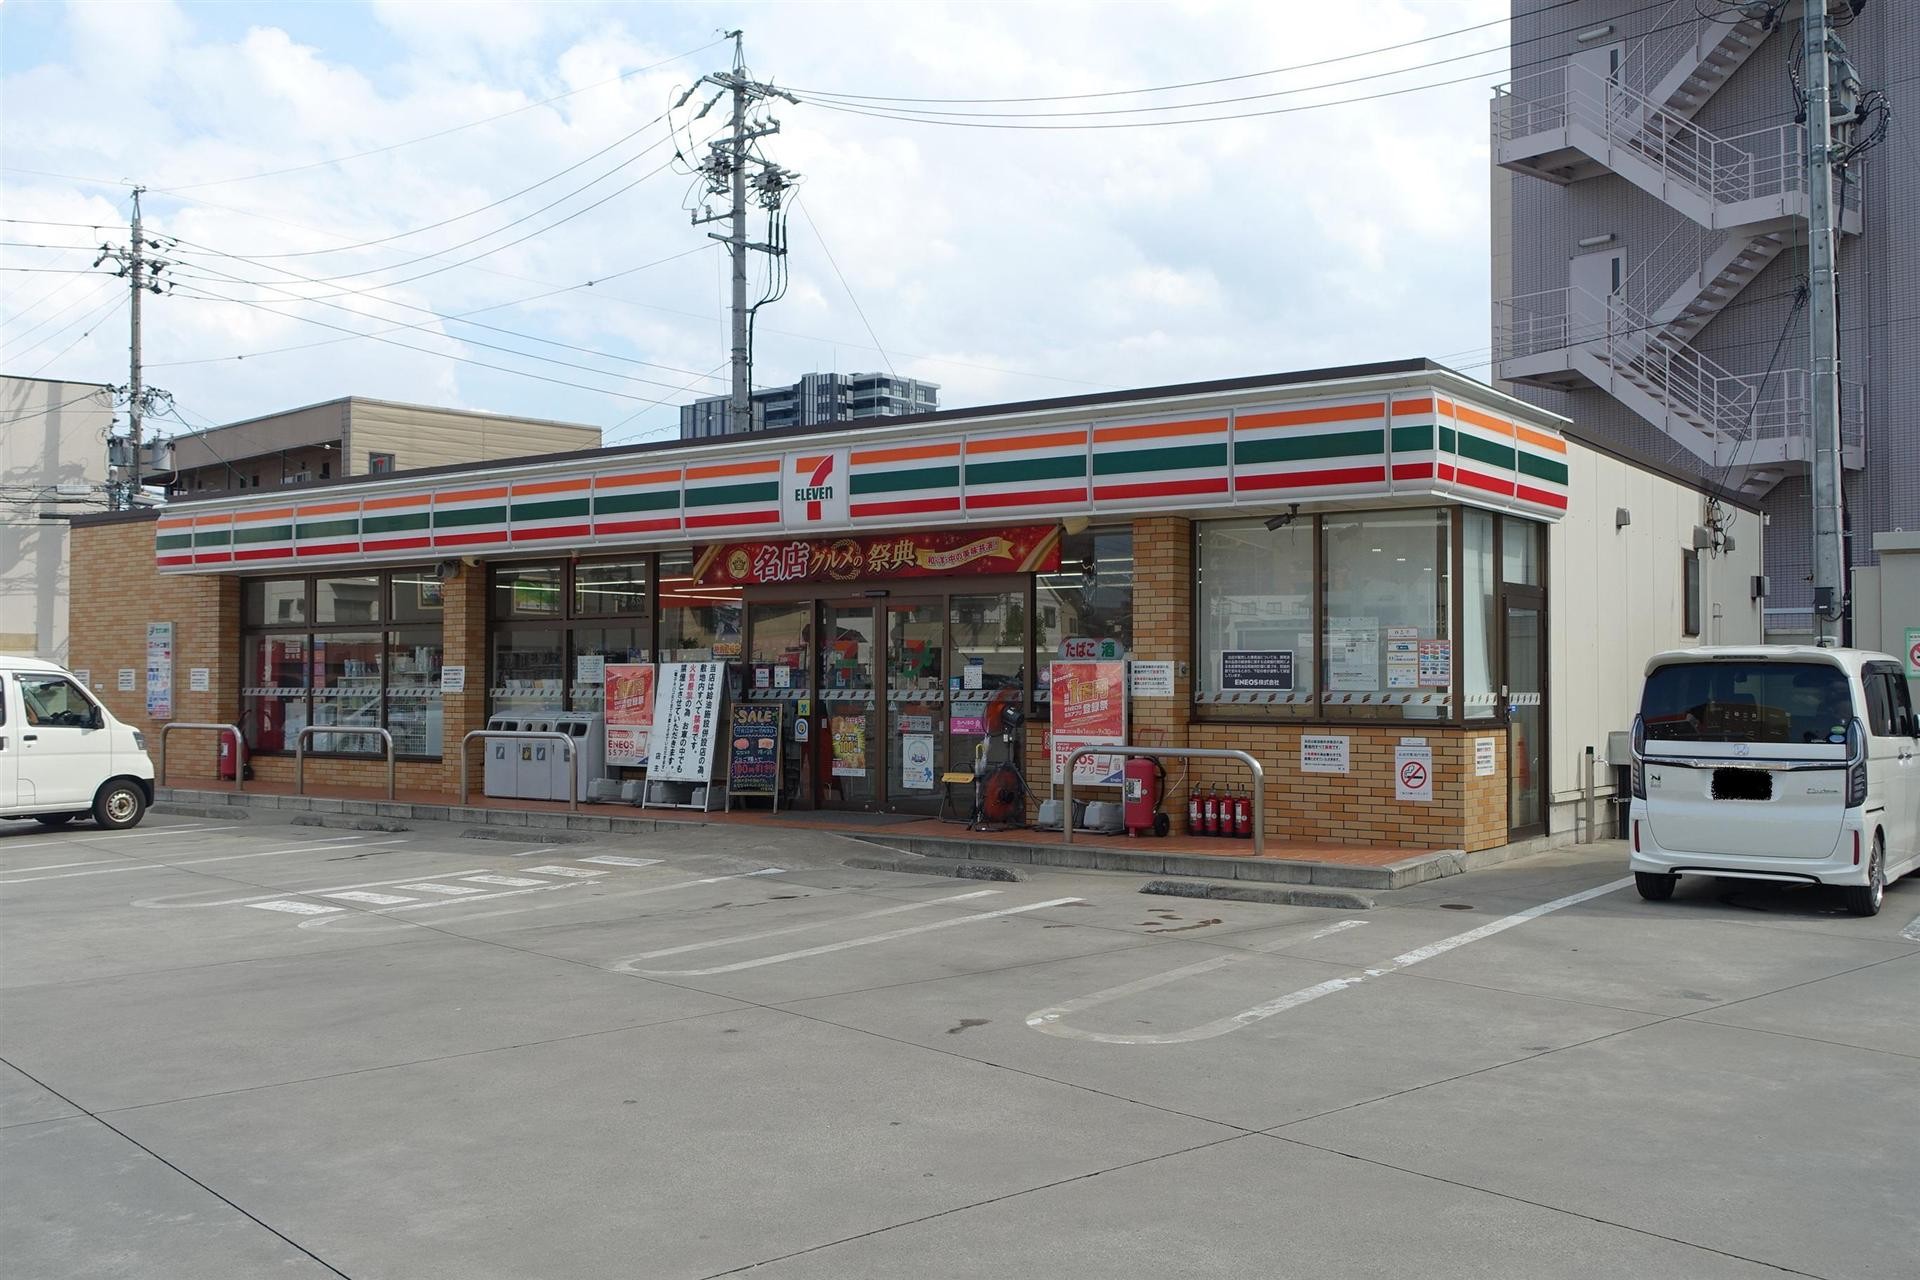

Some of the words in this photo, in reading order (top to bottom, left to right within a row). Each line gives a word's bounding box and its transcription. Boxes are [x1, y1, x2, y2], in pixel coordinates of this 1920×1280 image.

[1065, 641, 1096, 657] たばこ
[1101, 641, 1115, 657] 酒
[737, 709, 773, 724] SALE
[608, 740, 635, 749] ENEOS
[1056, 754, 1095, 765] ENOS
